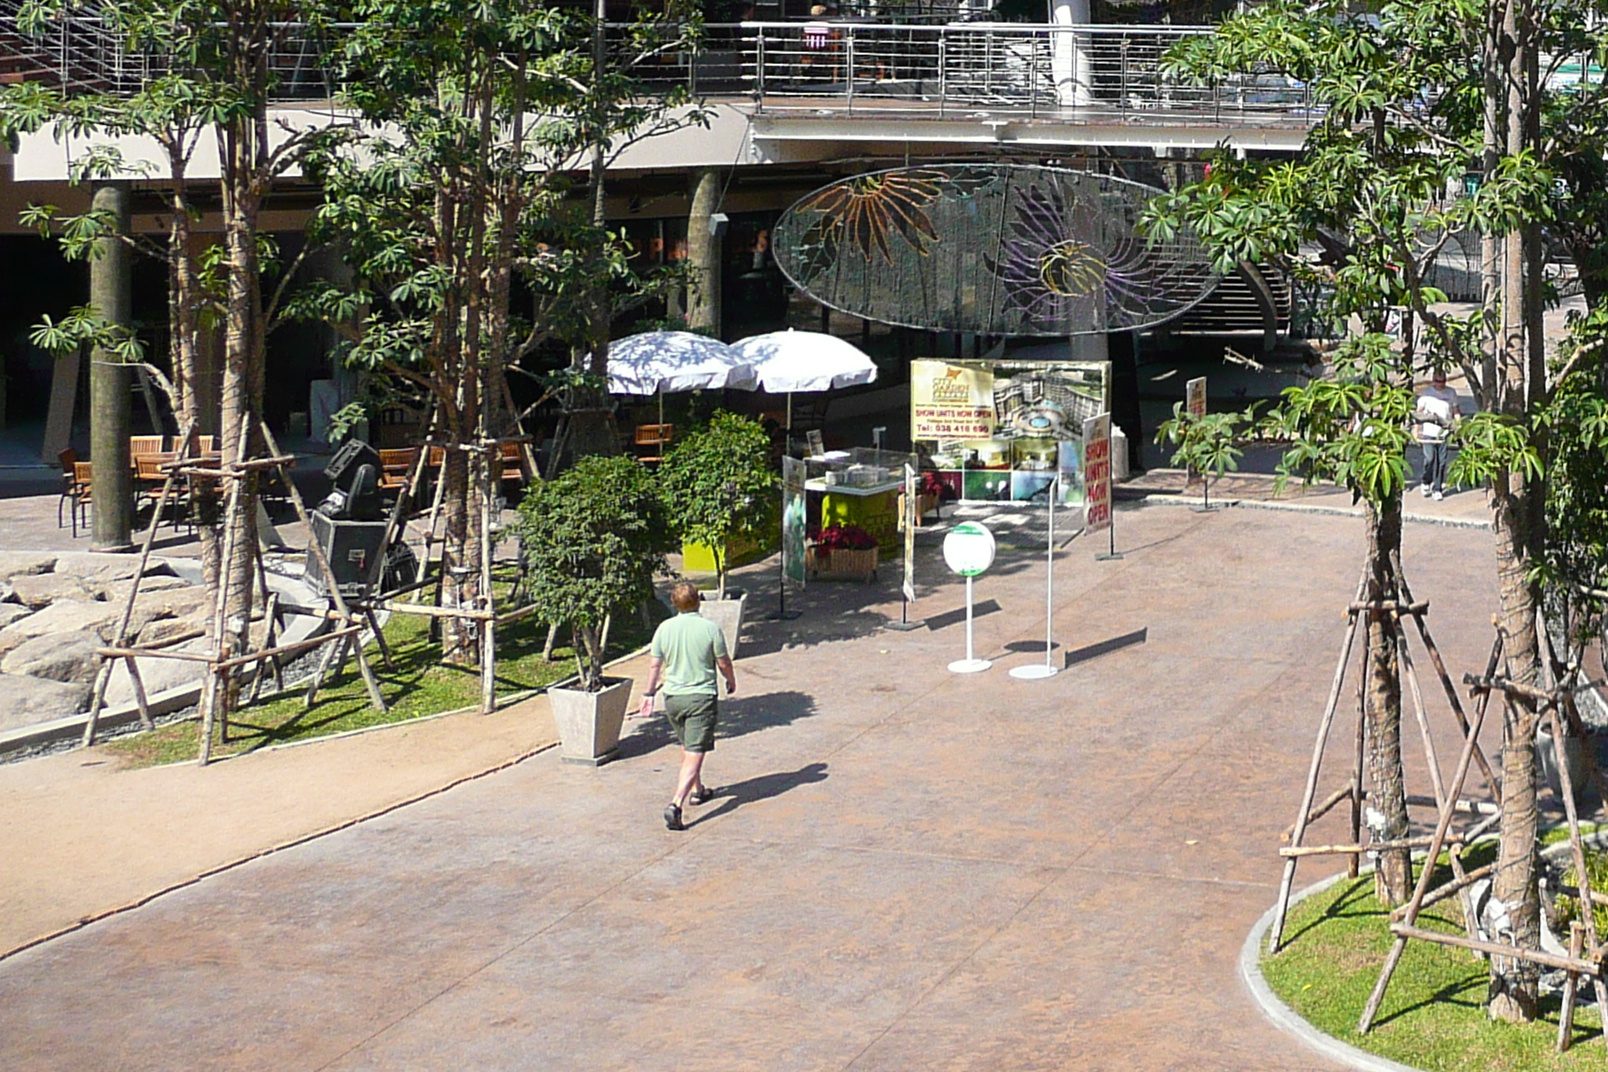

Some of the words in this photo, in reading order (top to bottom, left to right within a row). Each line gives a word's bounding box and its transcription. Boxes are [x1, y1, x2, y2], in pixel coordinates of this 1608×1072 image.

[1086, 439, 1109, 462] SHOW
[1086, 460, 1109, 483] UNITS
[1088, 482, 1107, 503] NOW
[1088, 502, 1109, 525] OPEN
